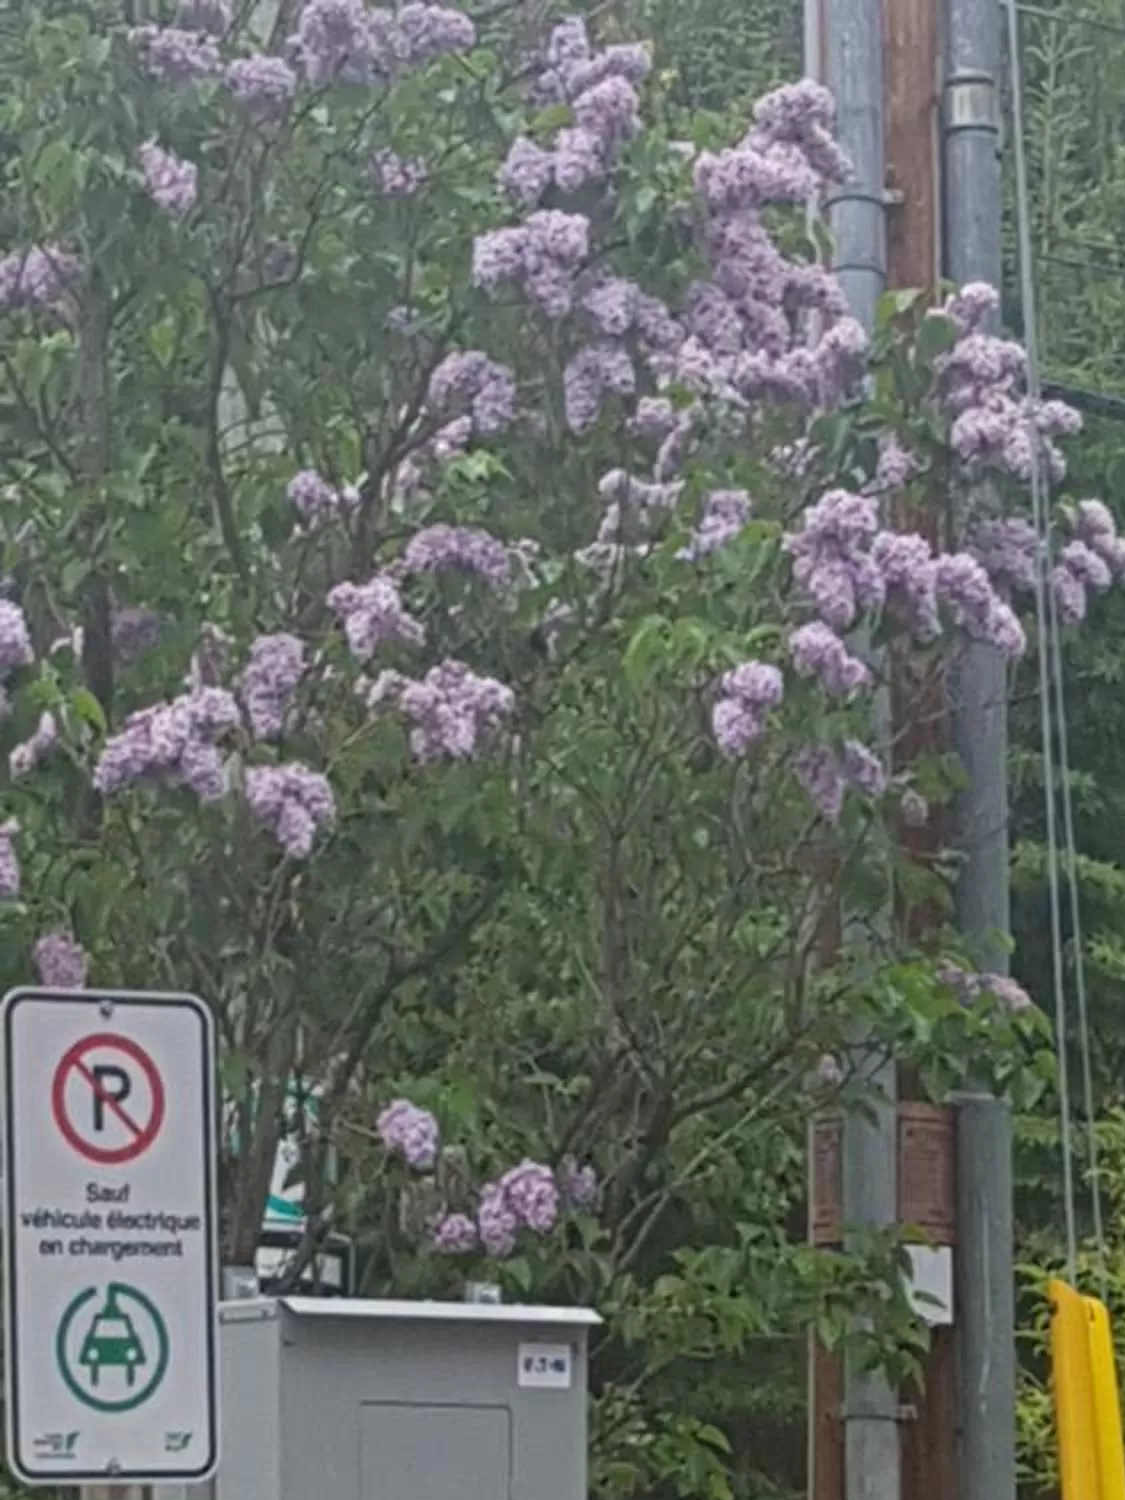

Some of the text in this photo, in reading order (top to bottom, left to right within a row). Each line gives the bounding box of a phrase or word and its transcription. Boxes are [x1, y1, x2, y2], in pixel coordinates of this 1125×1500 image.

[93, 1065, 131, 1131] P
[86, 1182, 130, 1203] Sauf
[21, 1208, 200, 1235] véhicule électrique
[39, 1236, 183, 1262] en chargement
